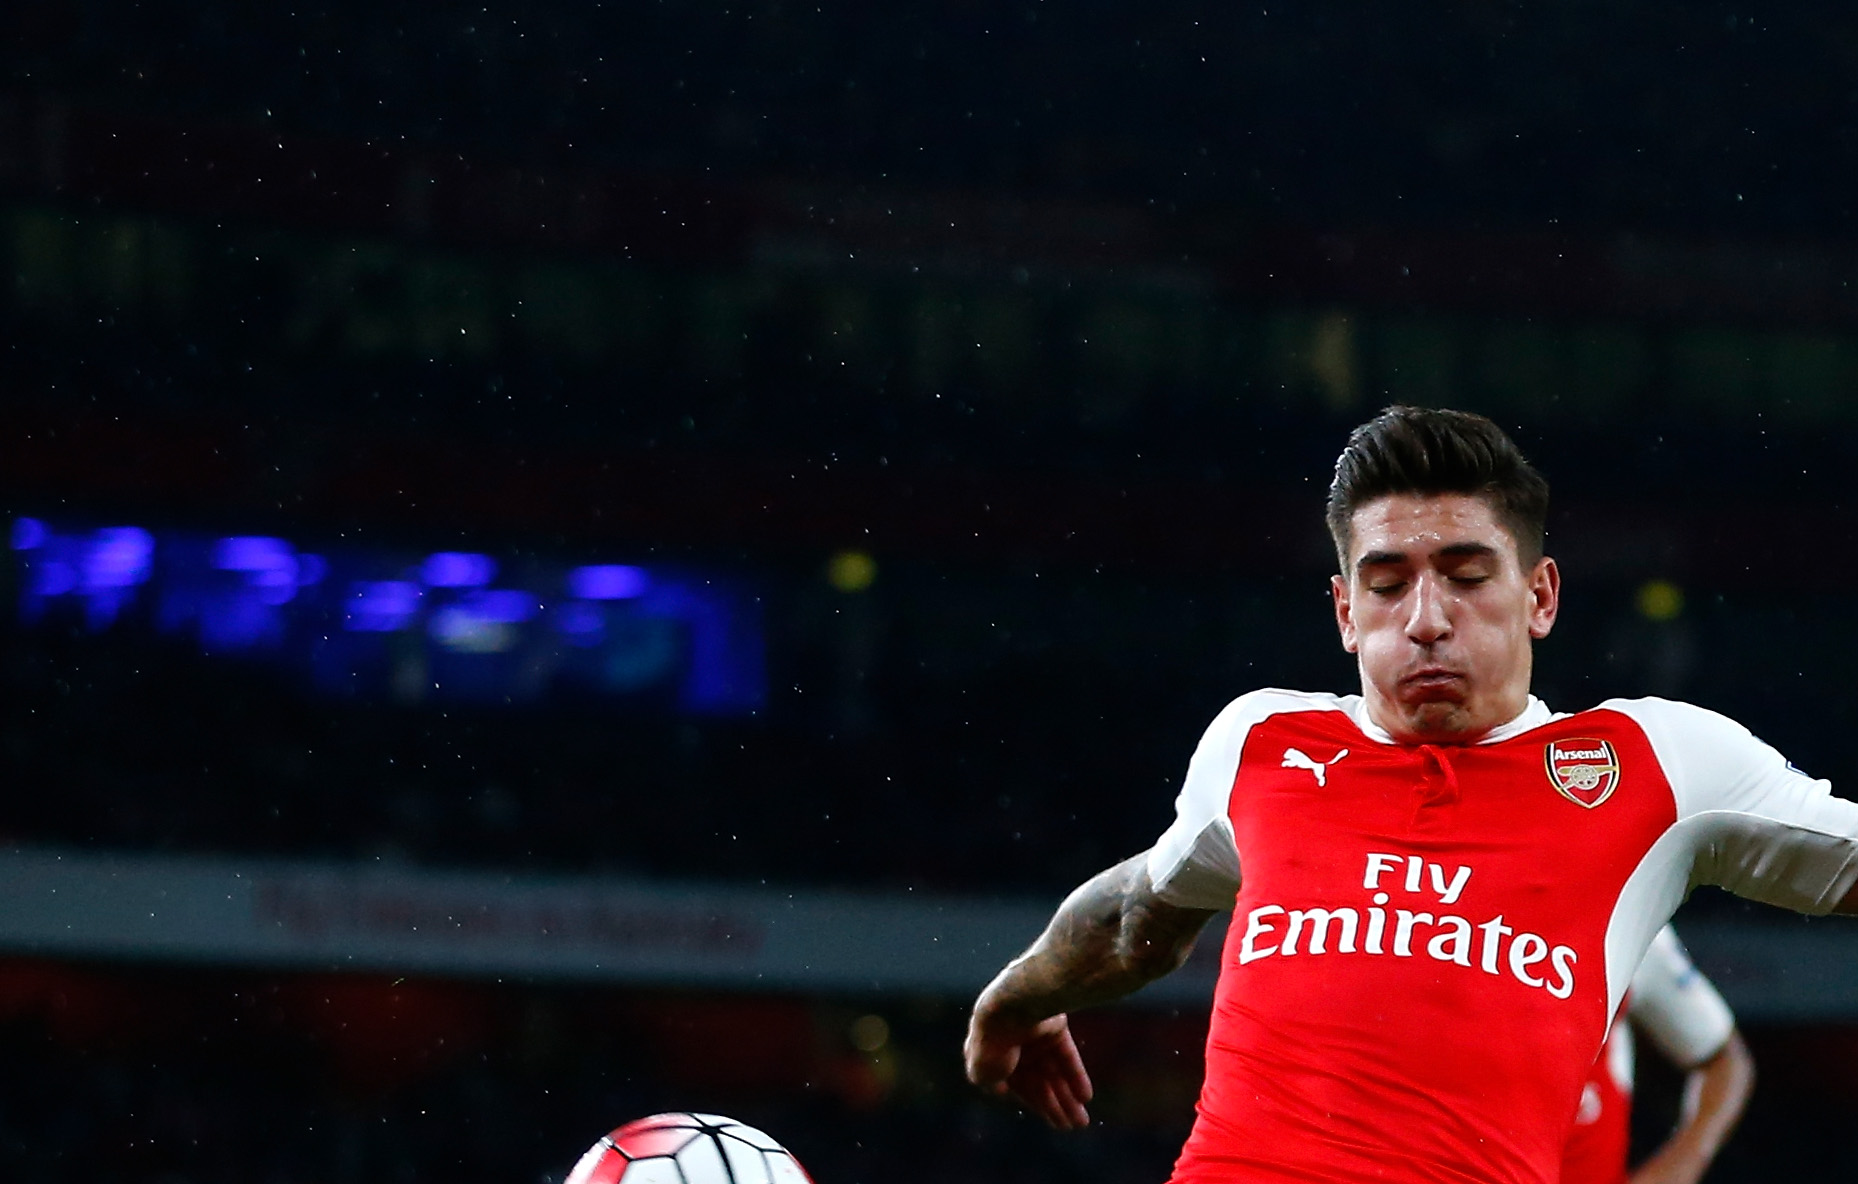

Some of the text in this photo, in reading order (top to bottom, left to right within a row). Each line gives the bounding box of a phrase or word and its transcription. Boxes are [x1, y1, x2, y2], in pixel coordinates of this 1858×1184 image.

[1555, 747, 1608, 760] Arsenal
[1362, 853, 1472, 904] Fly
[1239, 892, 1578, 999] Emirates
